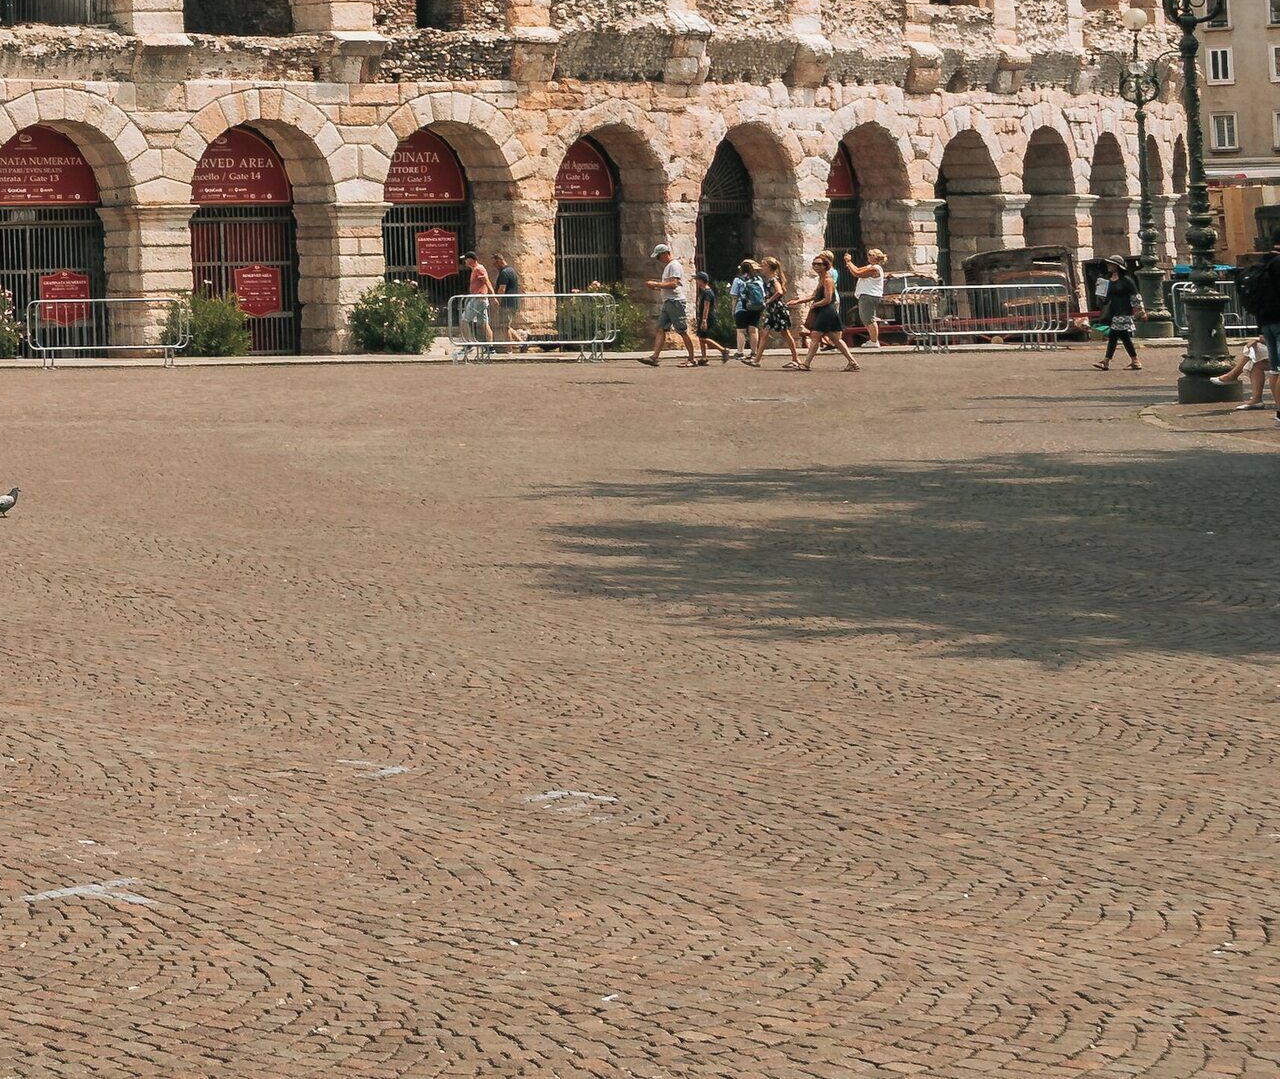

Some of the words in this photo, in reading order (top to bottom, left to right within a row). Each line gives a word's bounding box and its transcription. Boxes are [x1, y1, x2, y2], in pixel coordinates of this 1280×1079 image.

[28, 157, 83, 166] NUMERATA
[239, 158, 274, 168] AREA
[228, 172, 249, 181] Gate
[251, 172, 261, 180] 14
